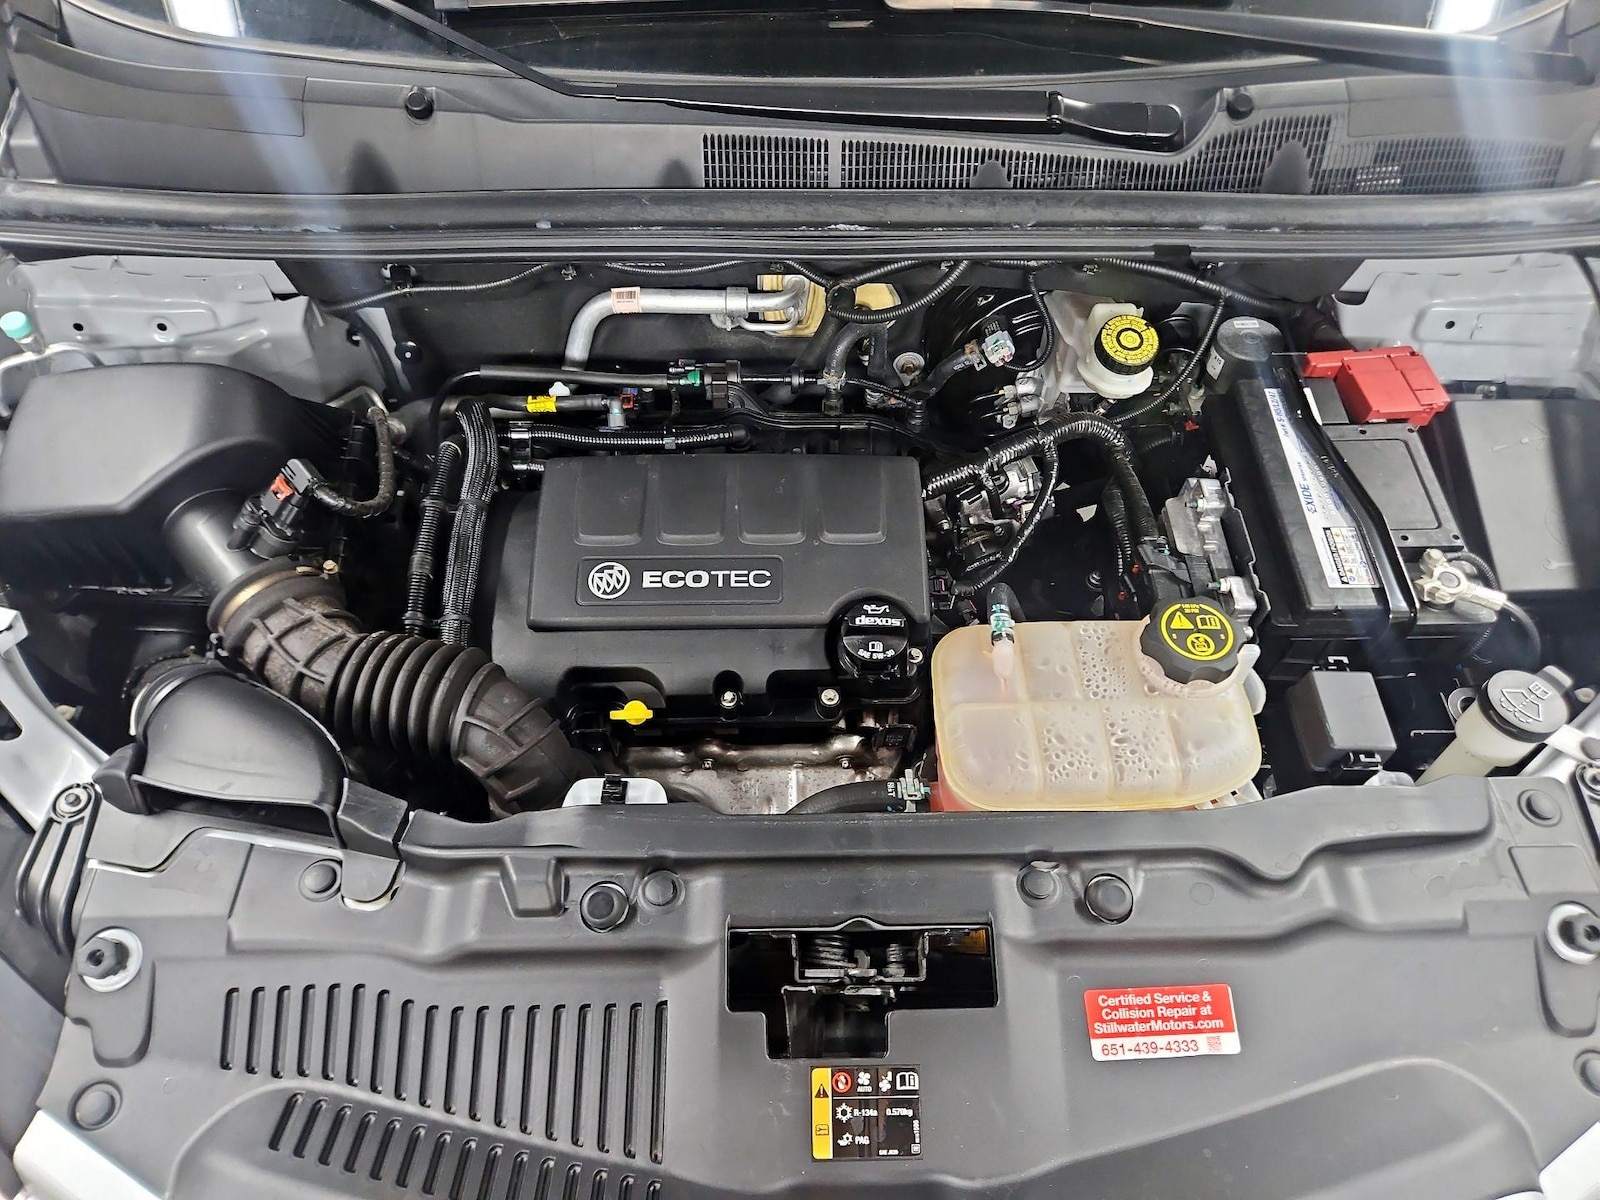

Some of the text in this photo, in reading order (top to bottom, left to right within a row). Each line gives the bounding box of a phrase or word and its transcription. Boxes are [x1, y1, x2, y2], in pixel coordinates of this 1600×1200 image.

[1300, 483, 1318, 514] EXIDE
[642, 569, 773, 589] ECOTEC
[855, 615, 903, 626] dexos
[858, 649, 895, 660] SAE 5W-30
[1098, 991, 1212, 1007] Certified Service &
[1101, 1005, 1212, 1020] Collision Repair at
[1094, 1018, 1224, 1034] StillwaterMotors.com
[1101, 1040, 1199, 1056] 651-439-4333
[853, 1108, 913, 1117] R-134a 0.570kg
[854, 1136, 870, 1145] PAG
